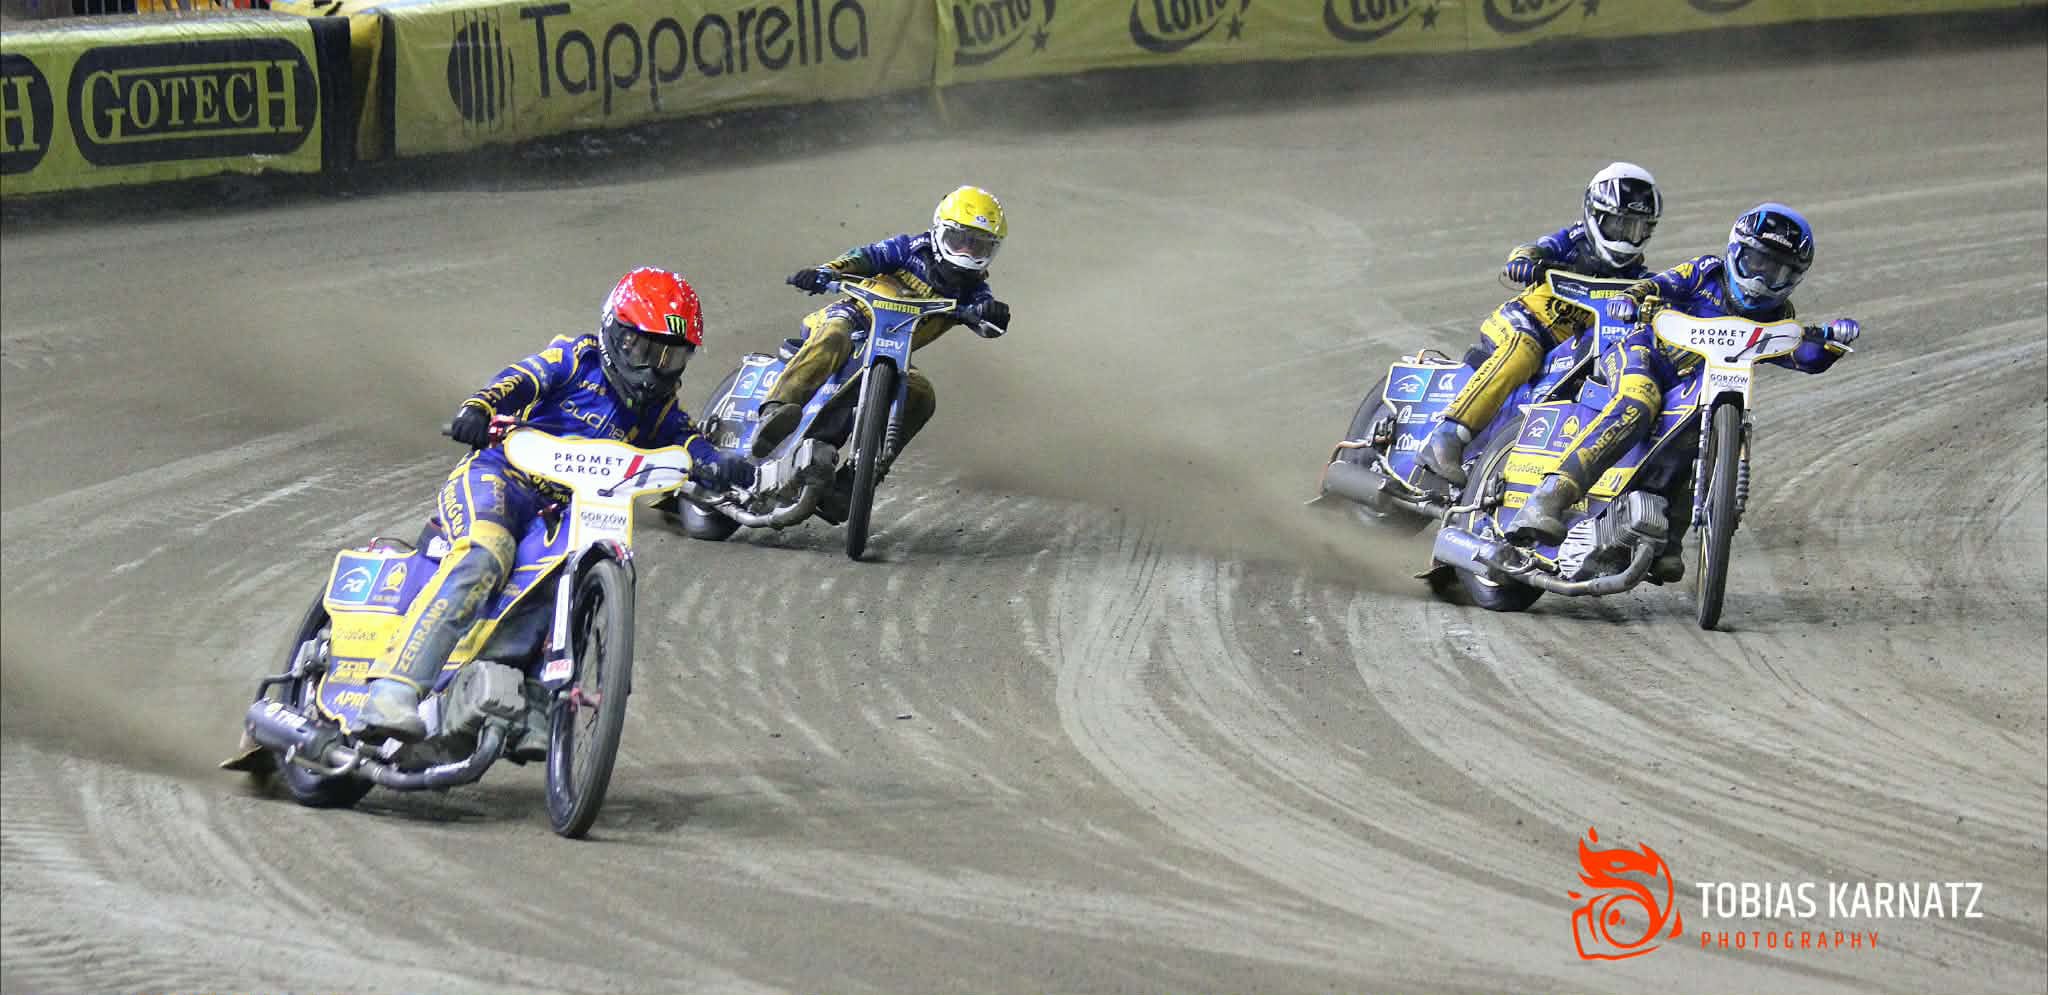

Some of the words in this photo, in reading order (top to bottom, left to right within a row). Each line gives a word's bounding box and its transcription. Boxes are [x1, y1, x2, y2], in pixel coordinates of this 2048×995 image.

[520, 0, 869, 115] Tapparella
[1691, 328, 1747, 338] PROMET
[1690, 337, 1735, 346] CARGO
[554, 453, 624, 467] PROMET
[554, 464, 611, 477] CARGO
